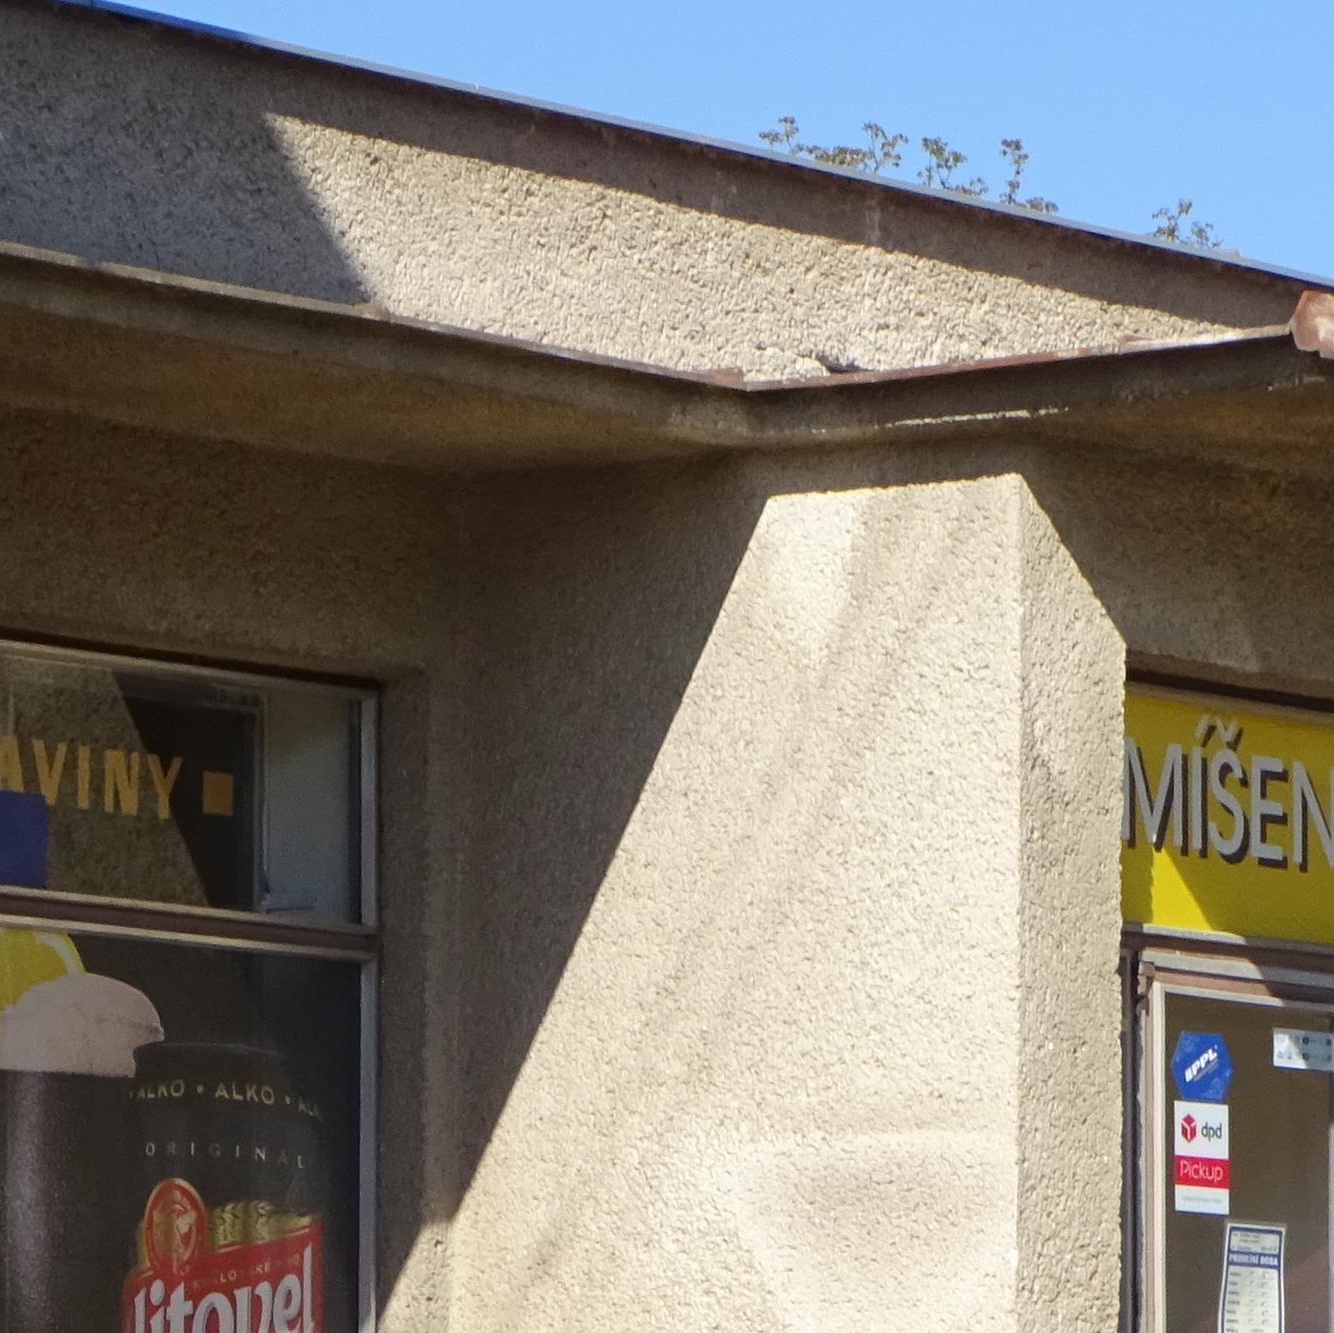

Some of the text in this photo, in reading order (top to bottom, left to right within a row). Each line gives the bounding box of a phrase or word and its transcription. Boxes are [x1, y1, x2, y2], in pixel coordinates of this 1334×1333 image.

[215, 1082, 276, 1106] ALKO
[1201, 1121, 1222, 1142] dpd
[1179, 1160, 1223, 1183] Pickup
